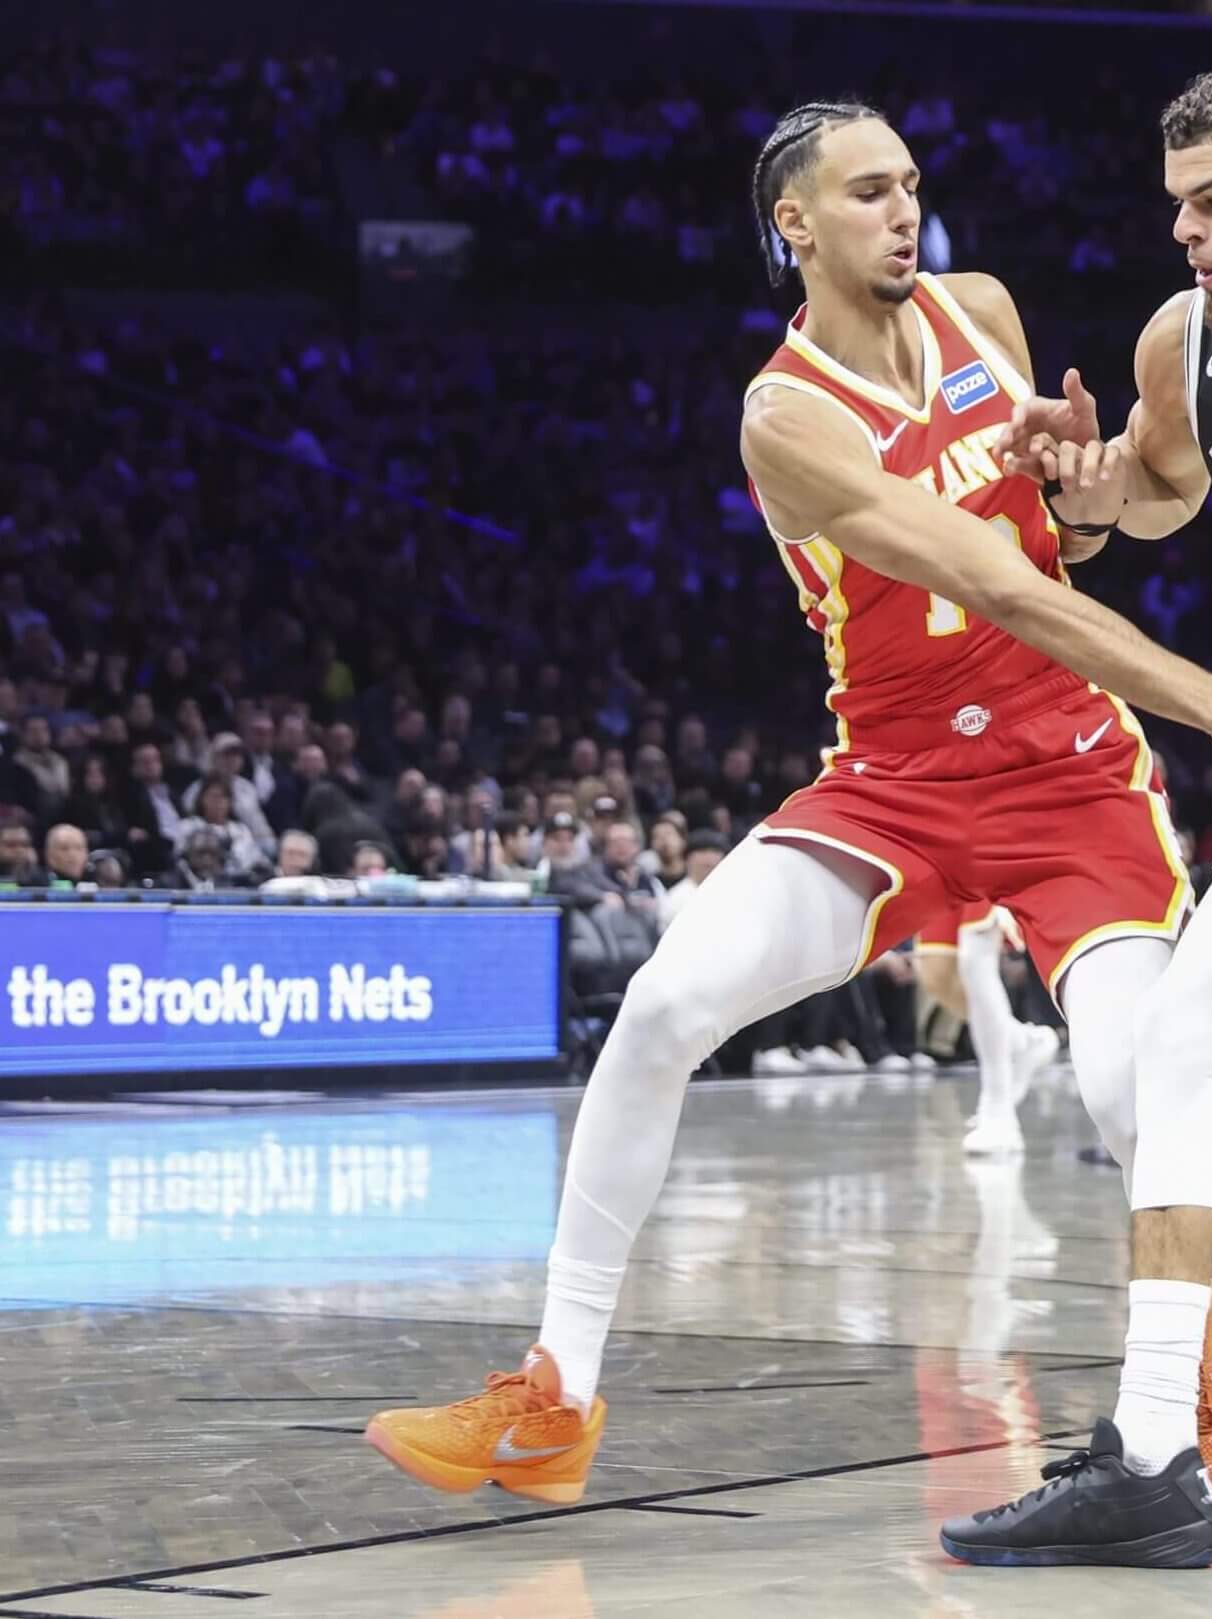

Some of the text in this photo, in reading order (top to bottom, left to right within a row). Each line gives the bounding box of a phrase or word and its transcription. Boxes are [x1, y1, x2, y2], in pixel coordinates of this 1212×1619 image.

[946, 372, 988, 404] paze
[7, 963, 433, 1037] the Brooklyn Nets
